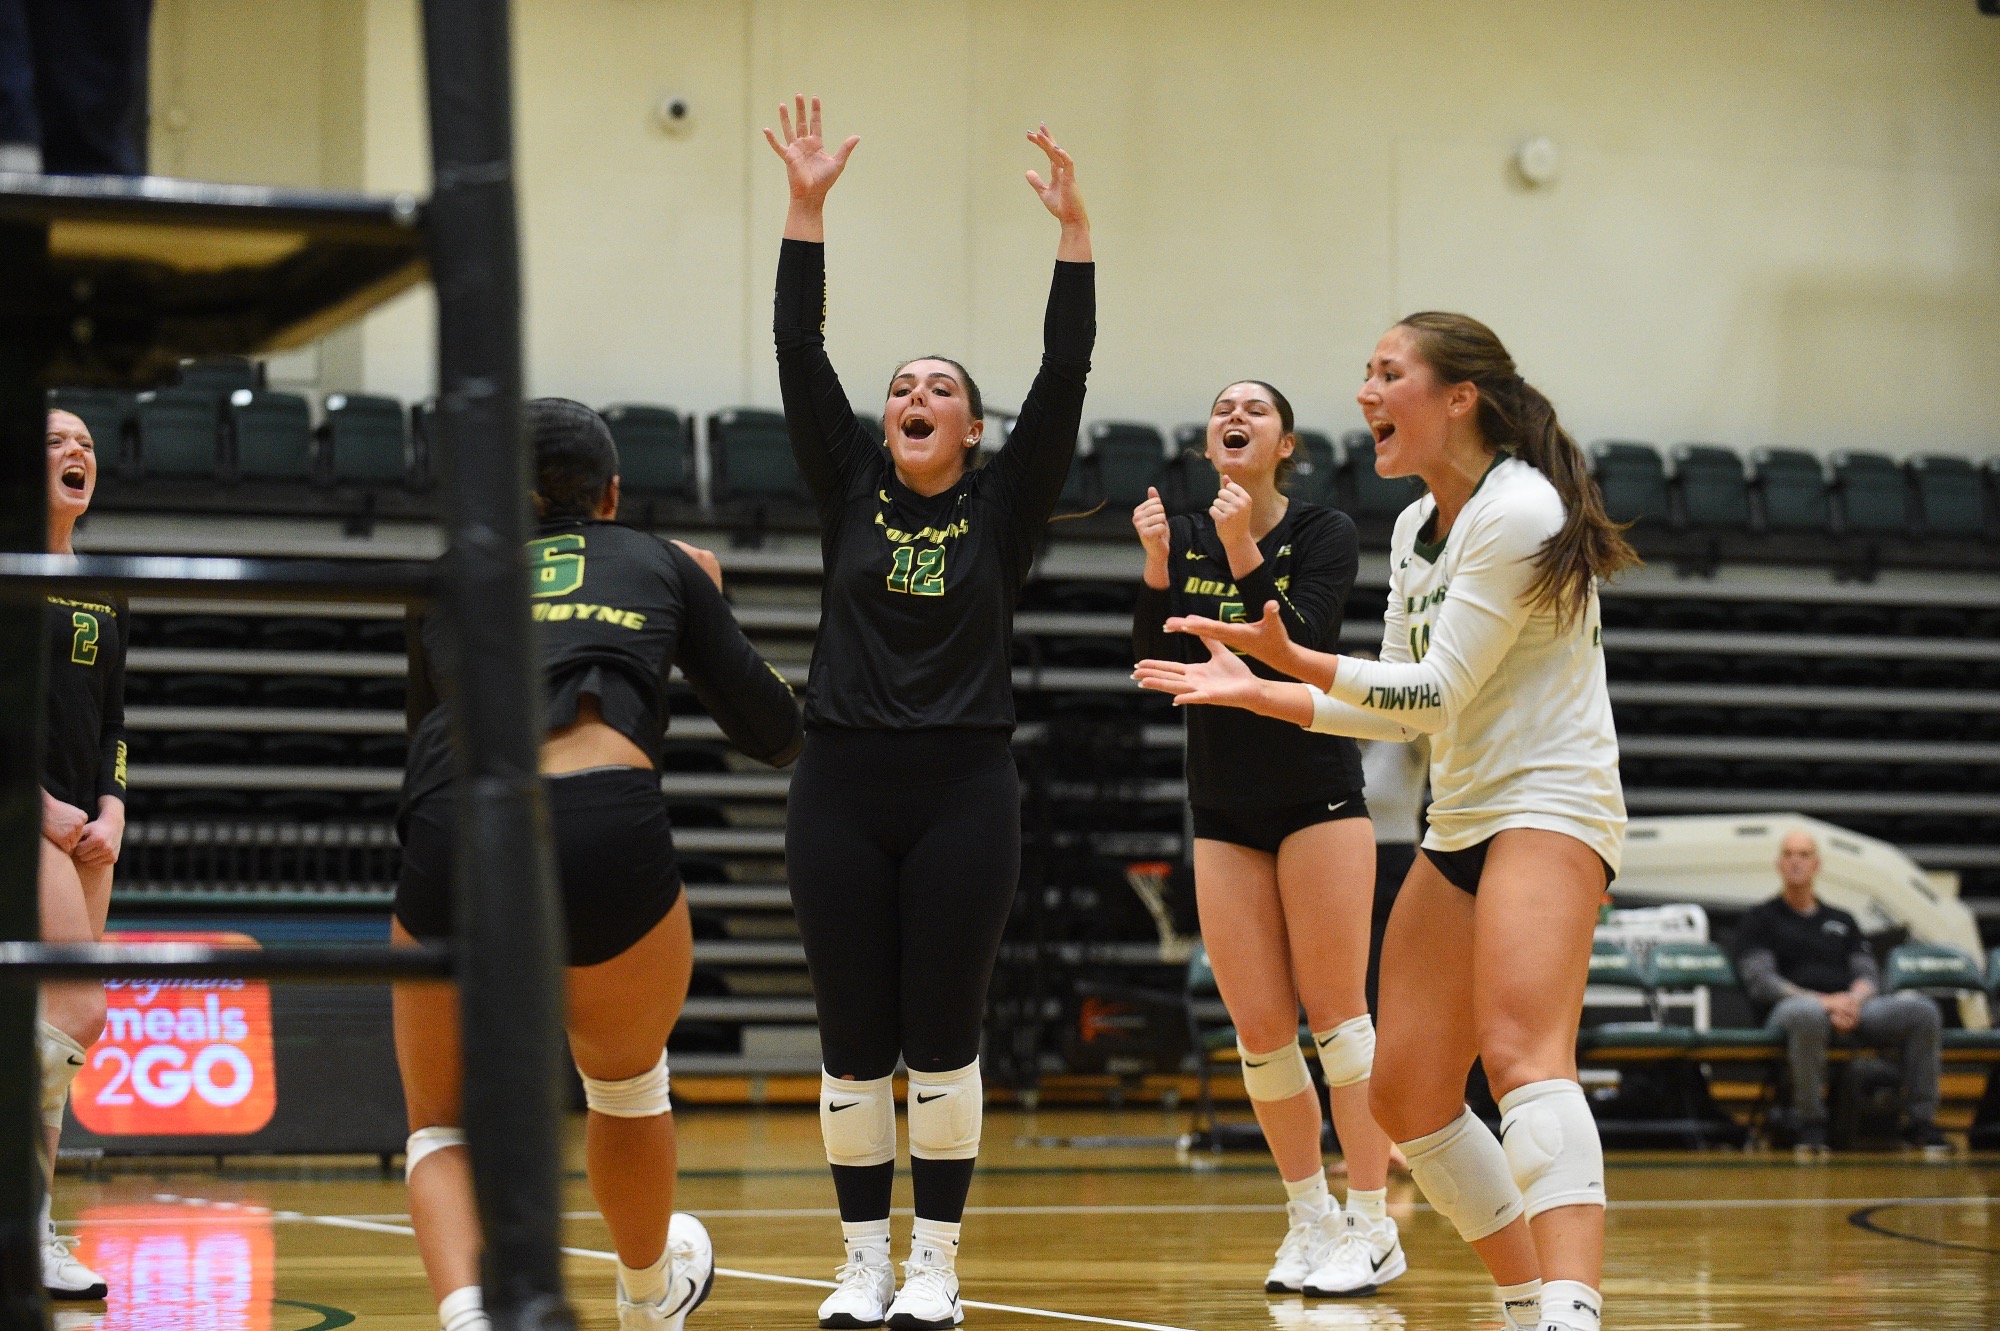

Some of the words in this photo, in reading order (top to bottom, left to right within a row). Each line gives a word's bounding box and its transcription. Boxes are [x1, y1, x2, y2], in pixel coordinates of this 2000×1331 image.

[526, 533, 586, 598] 6
[887, 545, 945, 596] 12
[72, 612, 99, 665] 2
[1361, 682, 1441, 710] PHAMILY
[100, 992, 249, 1042] meals
[93, 1043, 254, 1108] 2GO
